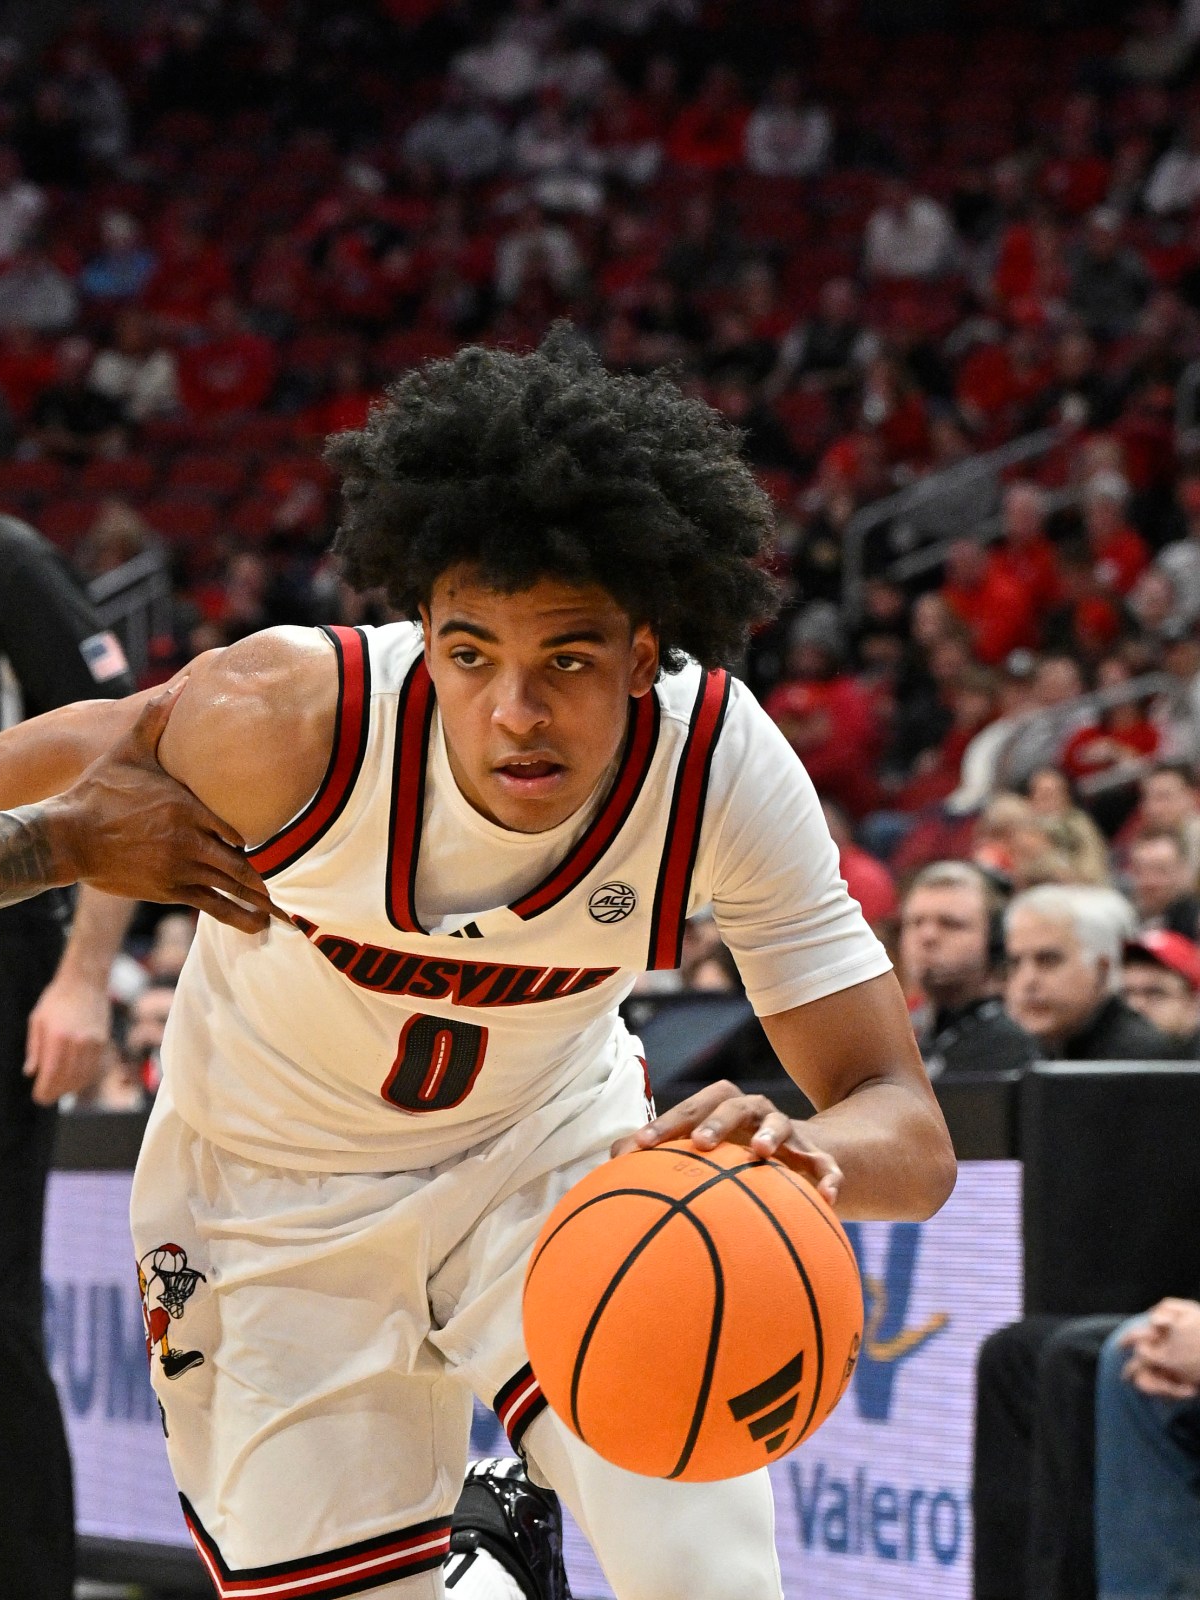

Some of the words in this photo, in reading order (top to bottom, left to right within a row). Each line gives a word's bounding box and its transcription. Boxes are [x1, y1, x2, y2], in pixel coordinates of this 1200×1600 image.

[593, 895, 636, 906] ACC
[380, 1012, 489, 1114] 0
[788, 1460, 961, 1565] Valero
